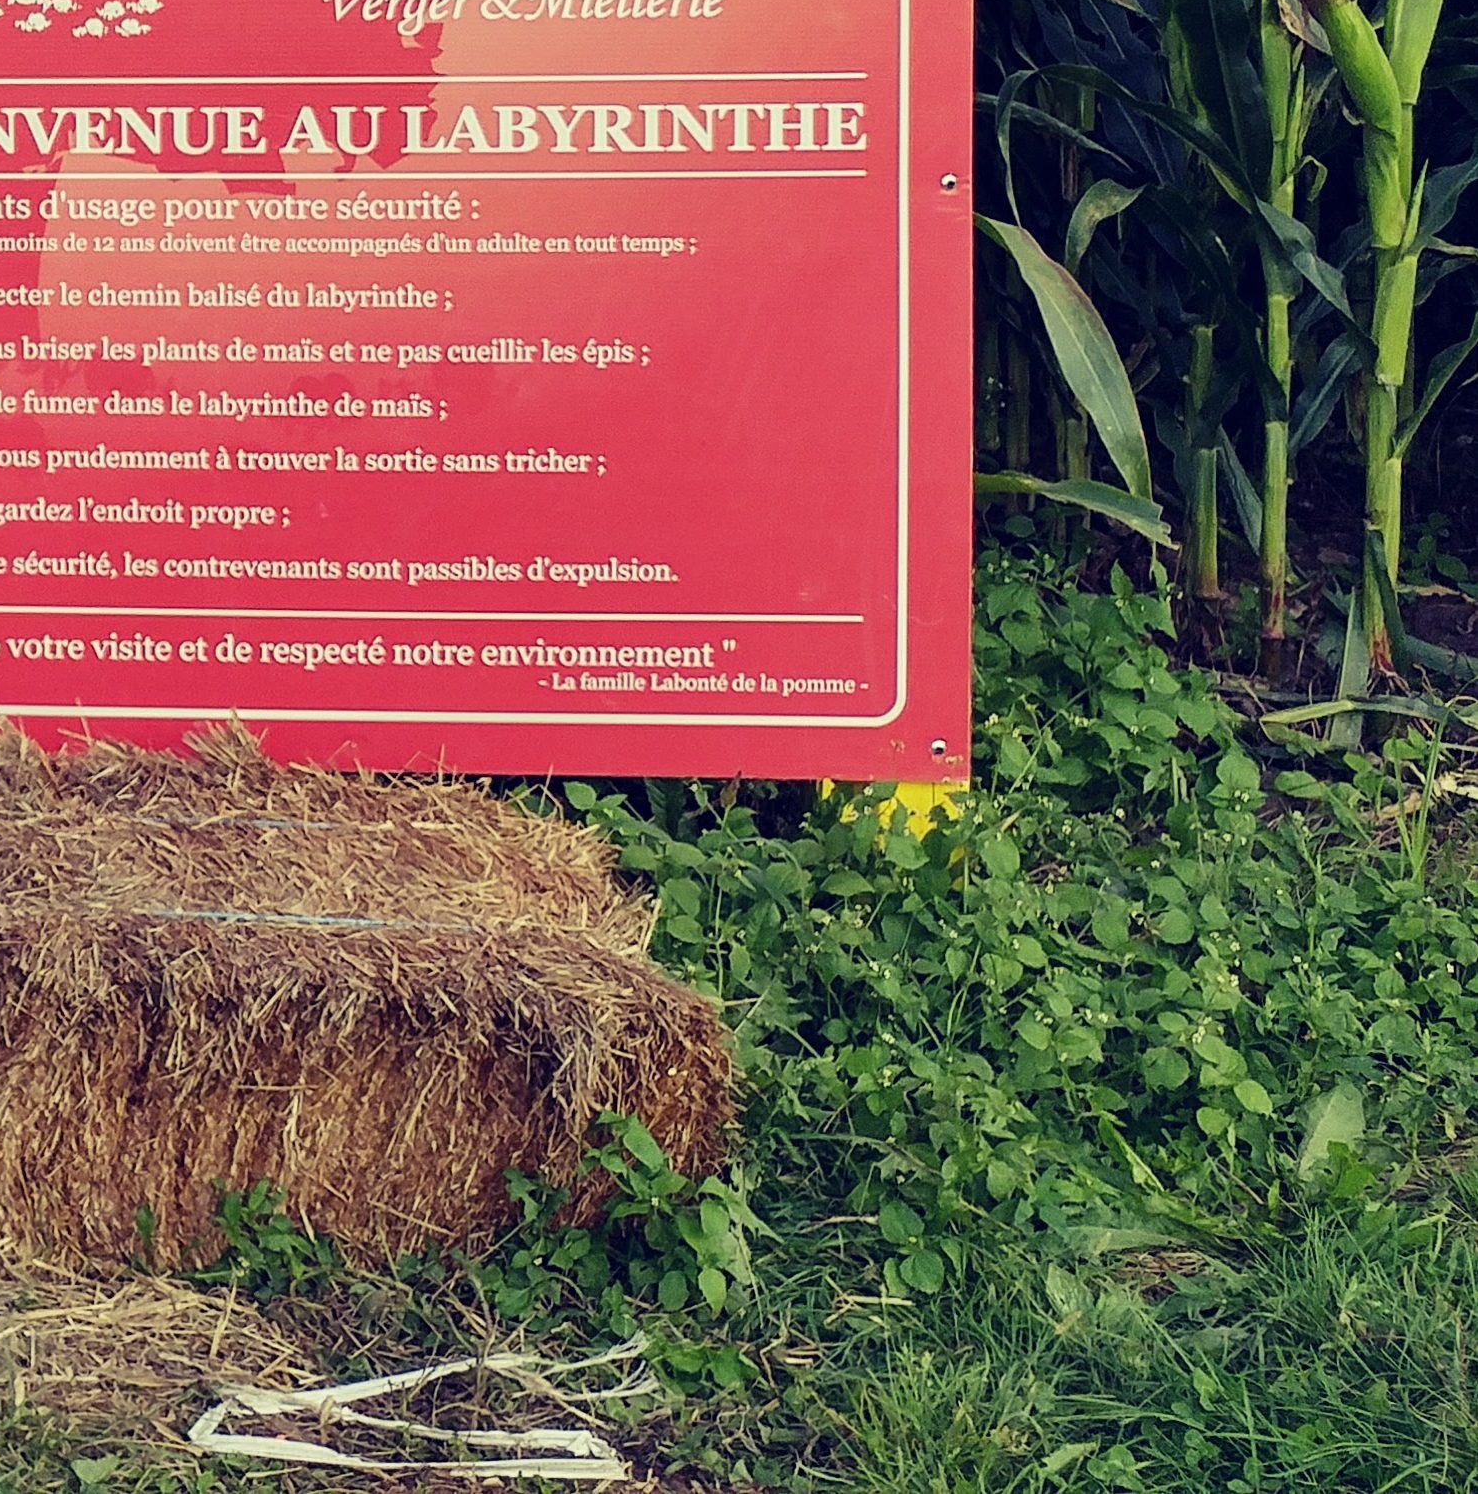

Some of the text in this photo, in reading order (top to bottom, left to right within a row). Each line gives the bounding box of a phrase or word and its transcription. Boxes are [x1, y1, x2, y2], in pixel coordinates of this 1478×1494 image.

[279, 105, 388, 155] AU
[399, 102, 868, 154] LABYRINTHE
[163, 199, 241, 227] pour
[245, 194, 329, 221] votre
[336, 190, 462, 221] sécurité
[62, 231, 88, 252] de
[92, 236, 116, 252] 12
[119, 237, 156, 252] ans
[159, 232, 237, 253] doivent
[240, 232, 282, 253] être
[285, 232, 424, 258] accompagnés
[475, 232, 543, 253] adulte
[544, 237, 572, 253] en
[574, 234, 619, 253] tout
[621, 234, 686, 258] temps
[58, 281, 83, 307] le
[87, 281, 182, 307] chemin
[186, 281, 262, 308] balisé
[266, 282, 302, 308] du
[305, 282, 439, 313] labyrinthe
[21, 335, 98, 361] briser
[100, 335, 137, 361] les
[141, 335, 221, 367] plants
[225, 336, 258, 362] de
[262, 337, 325, 363] maïs
[329, 340, 356, 363] et
[360, 344, 394, 363] ne
[397, 344, 443, 369] pas
[447, 337, 539, 364] cueillir
[540, 337, 580, 363] les
[582, 338, 637, 369] épis
[21, 388, 101, 416] fumer
[103, 389, 166, 416] dans
[169, 389, 195, 416] le
[197, 390, 331, 422] labyrinthe
[333, 391, 368, 418] de
[370, 393, 435, 418] maïs
[45, 442, 211, 475] prudemment
[215, 445, 233, 471] à
[235, 448, 333, 472] trouver
[334, 445, 361, 472] la
[364, 446, 439, 473] sortie
[442, 453, 502, 473] sans
[504, 447, 594, 473] tricher
[189, 505, 278, 531] propre
[11, 550, 119, 580] sécurité,
[122, 550, 160, 578] les
[163, 555, 343, 580] contrevenants
[346, 557, 404, 581] sont
[406, 555, 524, 587] passibles
[5, 633, 86, 661] votre
[89, 631, 174, 663] visite
[178, 636, 210, 663] et
[214, 633, 254, 664] de
[259, 635, 388, 672] respecté
[391, 640, 476, 667] notre
[480, 637, 715, 668] environnement
[551, 671, 578, 691] La
[579, 671, 647, 692] famille
[649, 671, 729, 693] Labonté
[731, 672, 757, 693] de
[759, 672, 780, 693] la
[781, 678, 857, 698] pomme
